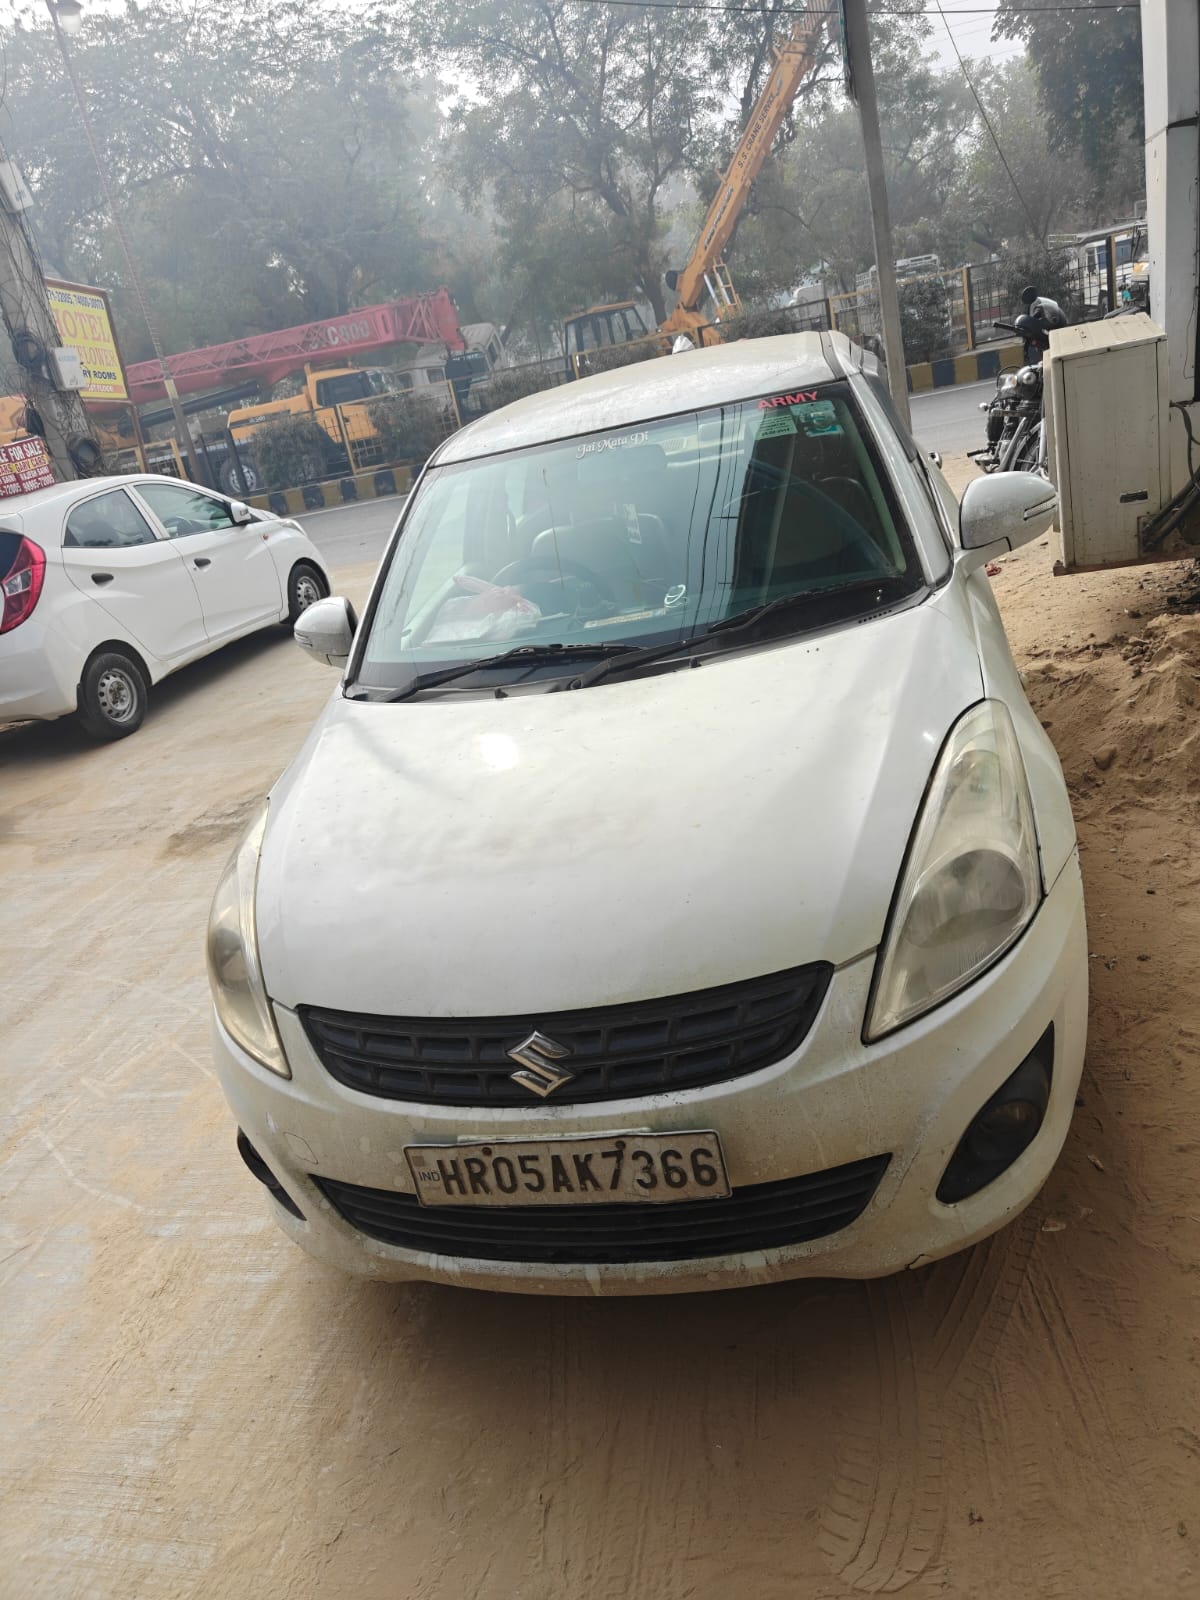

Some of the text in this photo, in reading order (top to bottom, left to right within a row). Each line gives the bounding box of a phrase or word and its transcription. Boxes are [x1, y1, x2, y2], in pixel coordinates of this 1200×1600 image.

[745, 121, 762, 151] CRANE
[93, 371, 117, 381] ROOMS
[757, 391, 818, 410] ARMY
[0, 441, 42, 462] LE FOR SALE
[575, 430, 649, 459] Jai Mata Di
[0, 463, 13, 475] ARS
[418, 1148, 719, 1196] IND HR05AK7366
